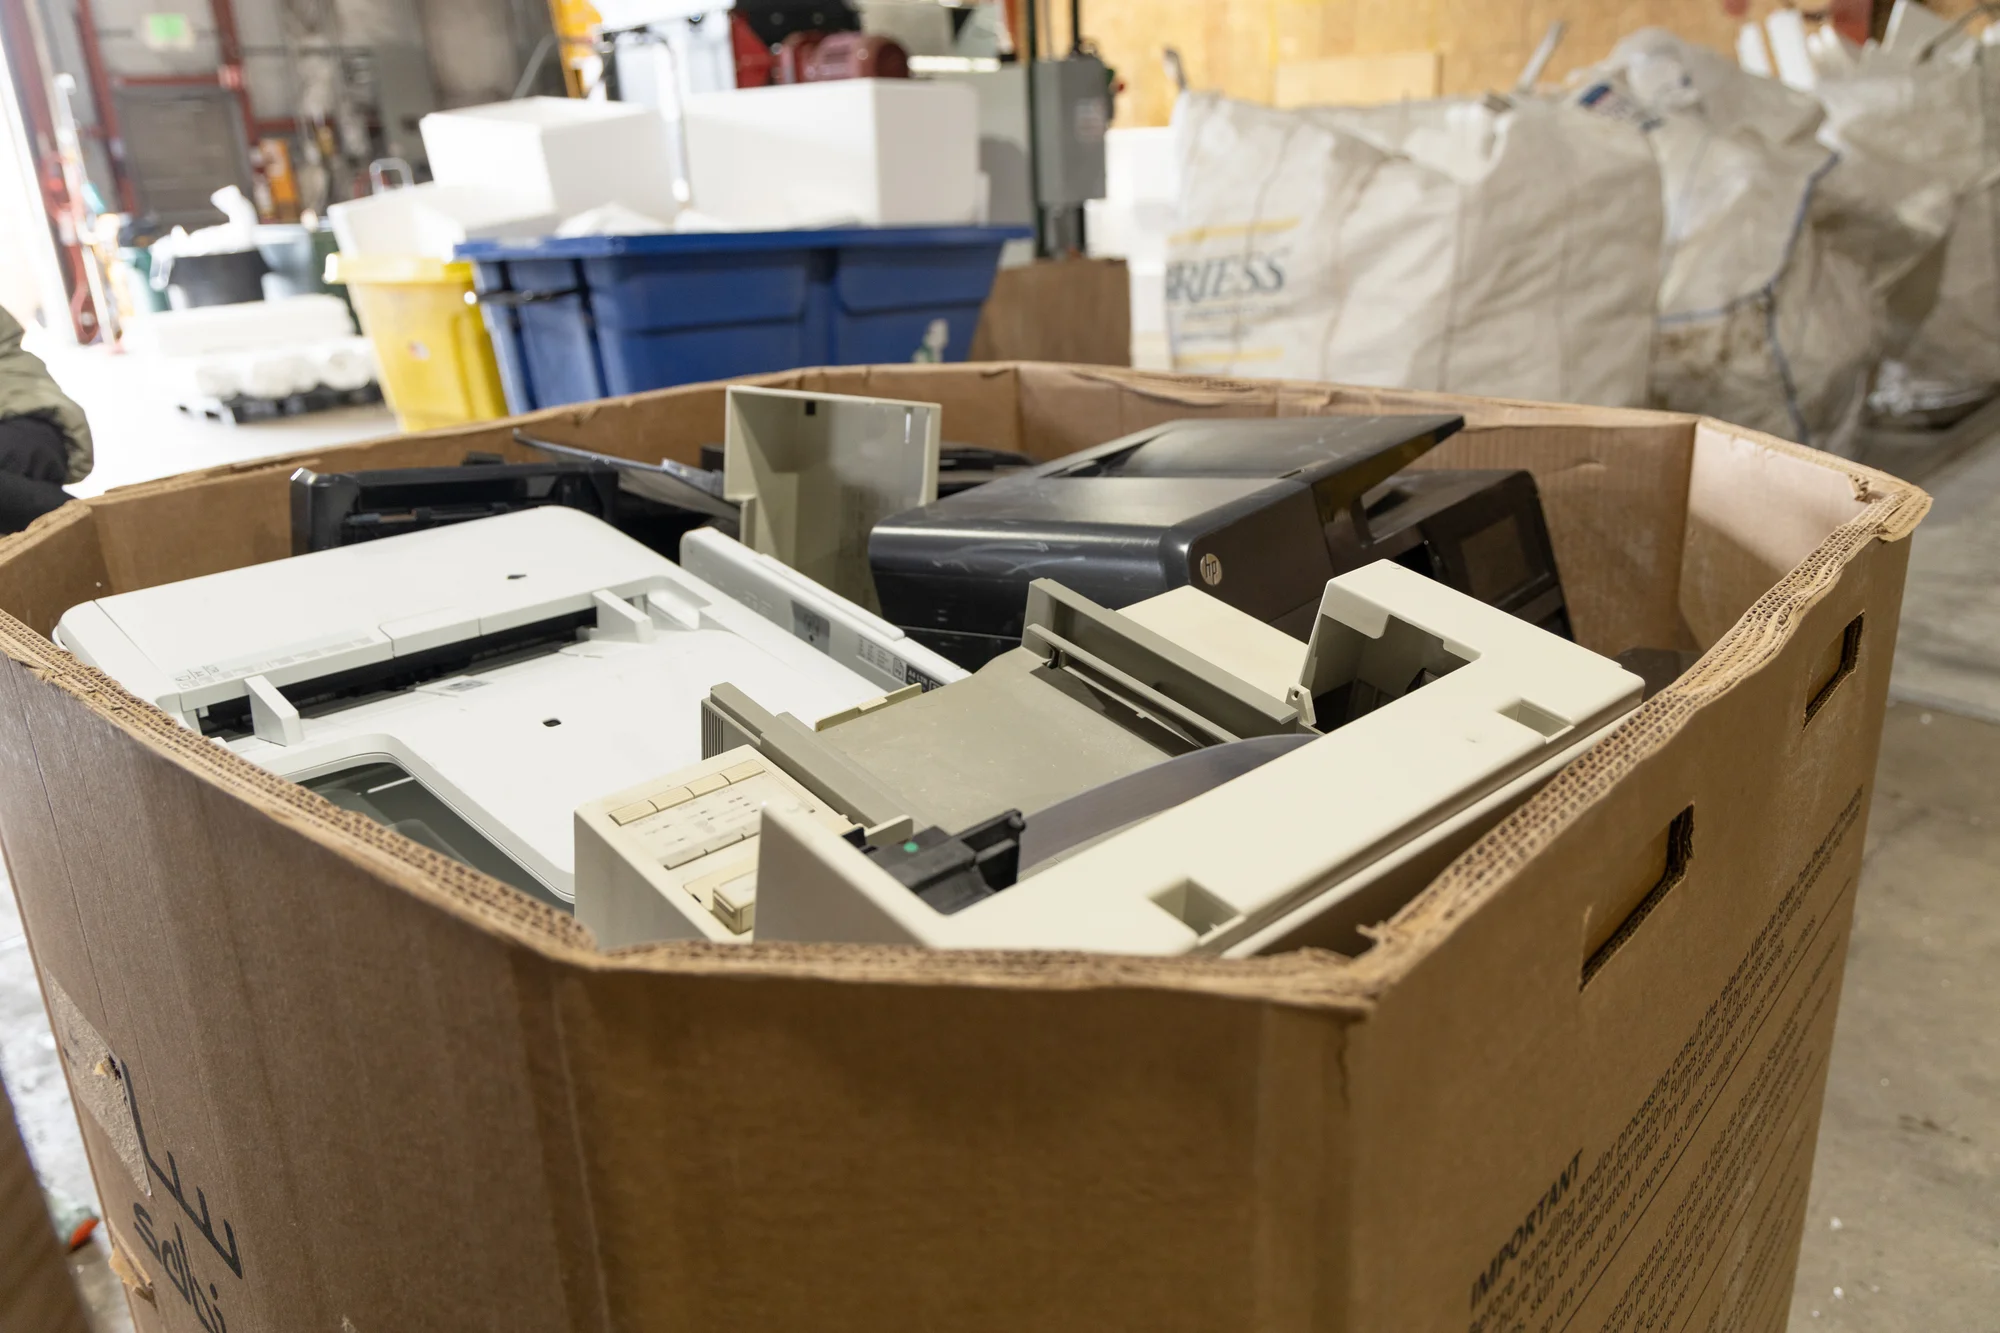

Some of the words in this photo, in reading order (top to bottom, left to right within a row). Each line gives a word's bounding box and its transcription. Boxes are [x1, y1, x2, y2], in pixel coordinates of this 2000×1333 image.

[1202, 554, 1219, 586] hp
[1519, 1191, 1577, 1279] handling
[1616, 1065, 1670, 1155] processing
[1672, 1016, 1704, 1073] consult
[1703, 997, 1718, 1028] the
[1718, 950, 1749, 1006] relevant
[1749, 906, 1777, 961] Material
[1528, 1270, 1556, 1320] skin
[1558, 1247, 1572, 1280] or
[1573, 1164, 1633, 1258] respiratory
[1634, 1120, 1661, 1172] tract.
[1662, 1099, 1678, 1132] Dry
[1679, 1073, 1692, 1106] all
[1692, 1024, 1725, 1087] material
[1725, 991, 1748, 1037] before
[1533, 1249, 1553, 1288] for
[1555, 1173, 1605, 1259] detailed
[1606, 1090, 1668, 1189] information.
[1669, 1048, 1697, 1100] Fumes
[1697, 1014, 1720, 1061] given
[1720, 992, 1732, 1023] off
[1731, 982, 1742, 1006] by
[1555, 1279, 1576, 1320] dry
[1577, 1237, 1602, 1289] and
[1602, 1222, 1617, 1254] do
[1618, 1188, 1638, 1230] not
[1638, 1141, 1671, 1201] expose
[1672, 1123, 1683, 1150] to
[1684, 1082, 1708, 1131] direct
[1709, 1034, 1738, 1092] sunlight
[1738, 1023, 1747, 1045] or
[1665, 1172, 1700, 1238] consulte
[1700, 1158, 1708, 1180] la
[1708, 1128, 1726, 1166] Hoja
[1725, 1110, 1737, 1137] de
[1470, 1147, 1582, 1313] IMPORTANT
[1635, 1215, 1685, 1310] pertinentes
[1685, 1183, 1704, 1228] para
[1704, 1133, 1733, 1191] obtener
[1657, 1246, 1682, 1298] resina
[1682, 1194, 1712, 1255] fundida
[1669, 1245, 1693, 1296] todos
[1693, 1223, 1705, 1254] los
